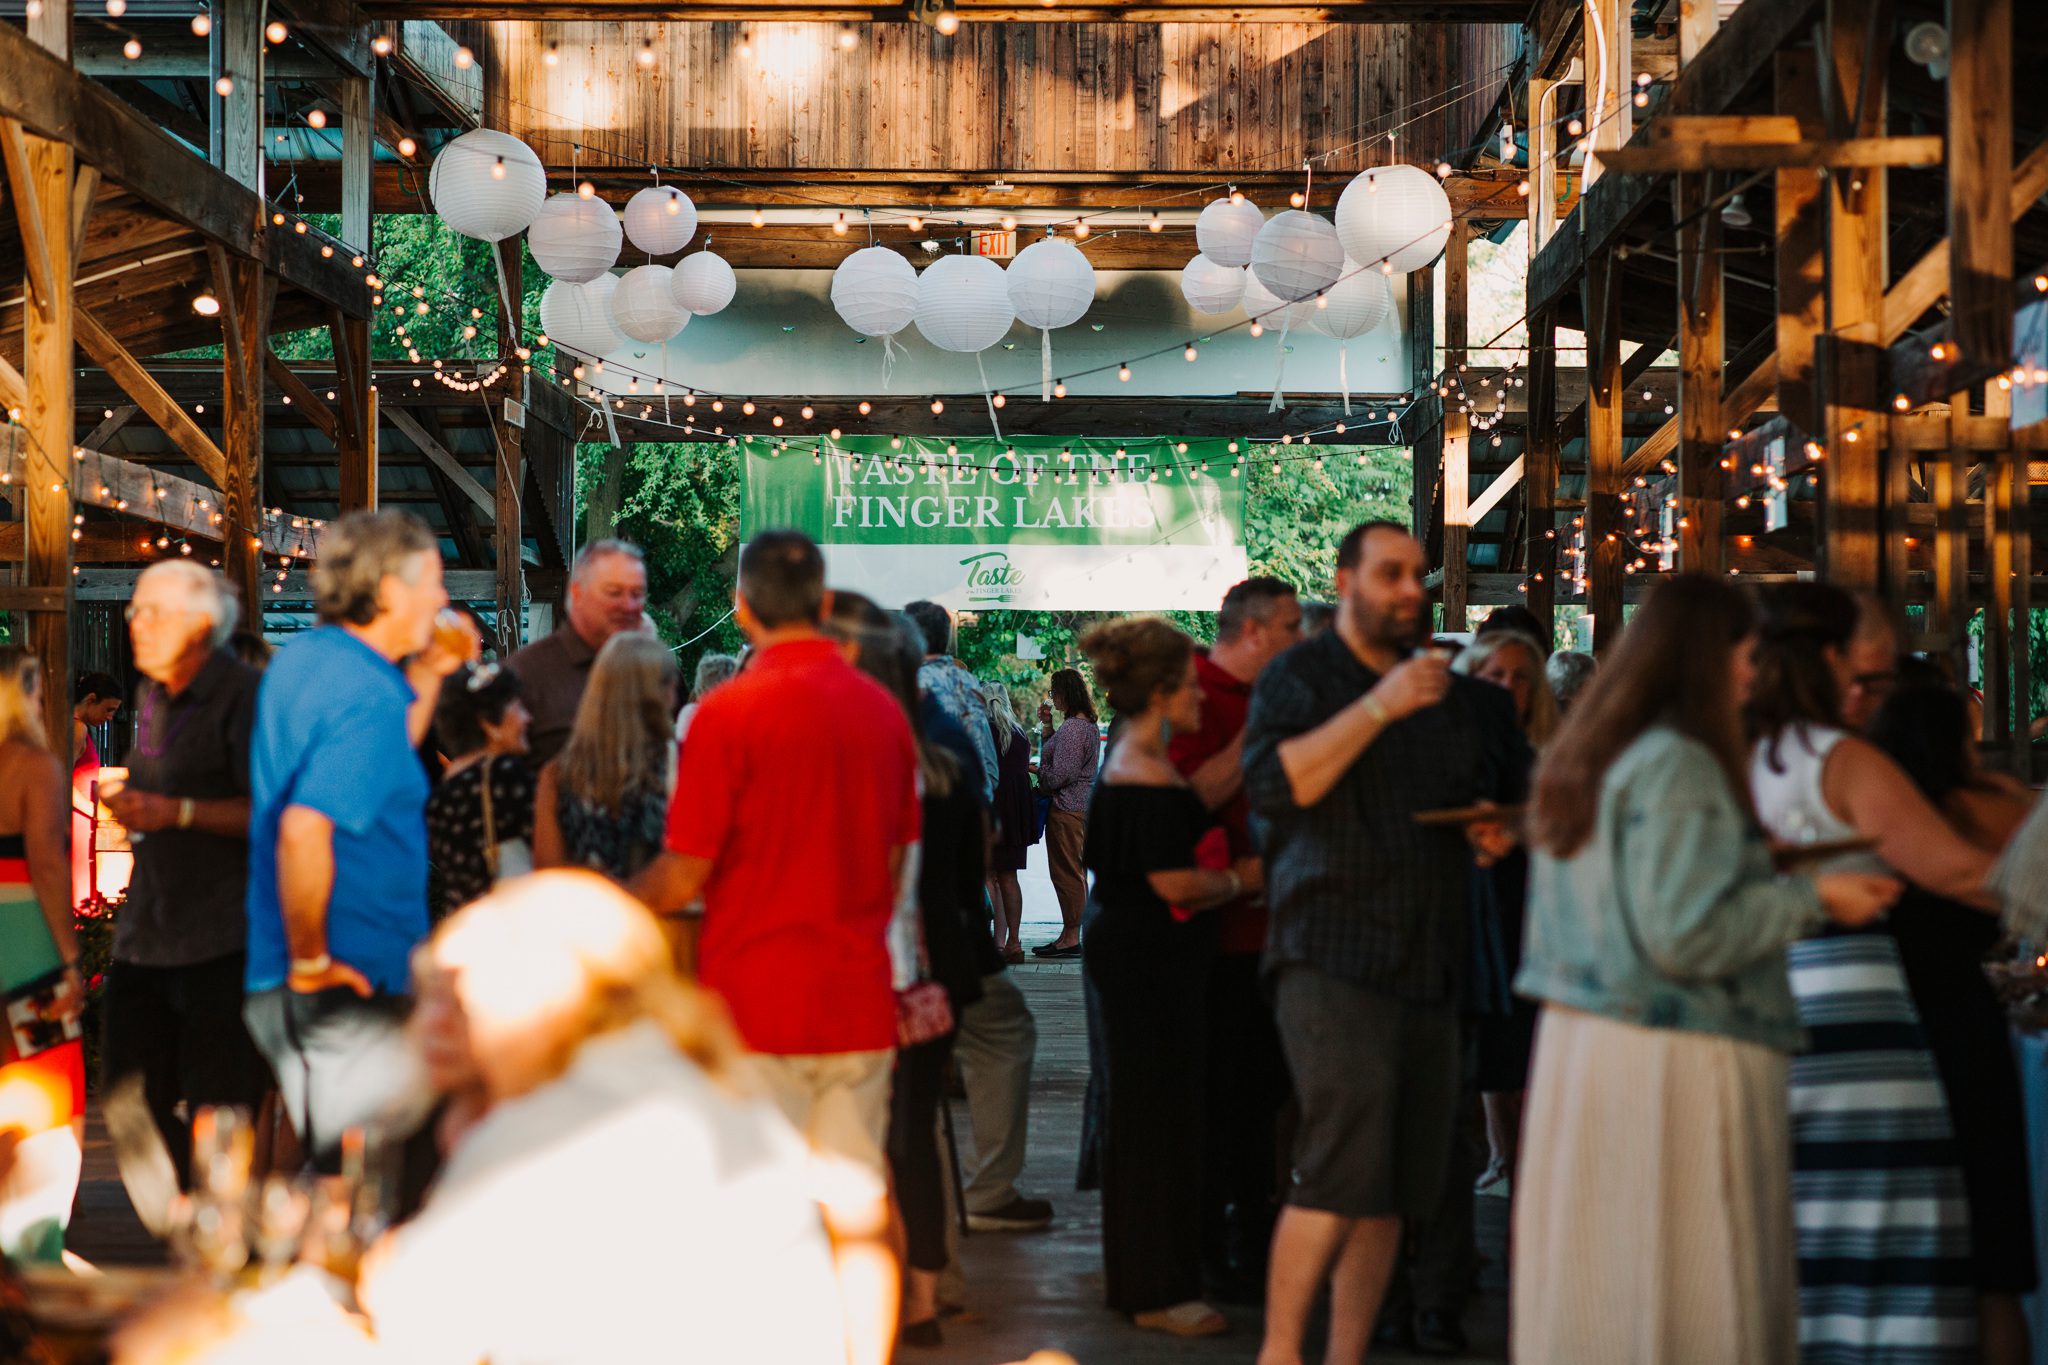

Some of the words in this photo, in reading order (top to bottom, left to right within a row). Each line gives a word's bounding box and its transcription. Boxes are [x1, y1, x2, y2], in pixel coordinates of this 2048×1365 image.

[979, 232, 1009, 256] EXIT
[832, 453, 976, 485] TASTE
[989, 453, 1048, 485] OF
[1057, 453, 1152, 485] THE
[832, 496, 1004, 528] FINGER
[1013, 496, 1154, 528] LAKES
[960, 552, 1025, 587] Taste
